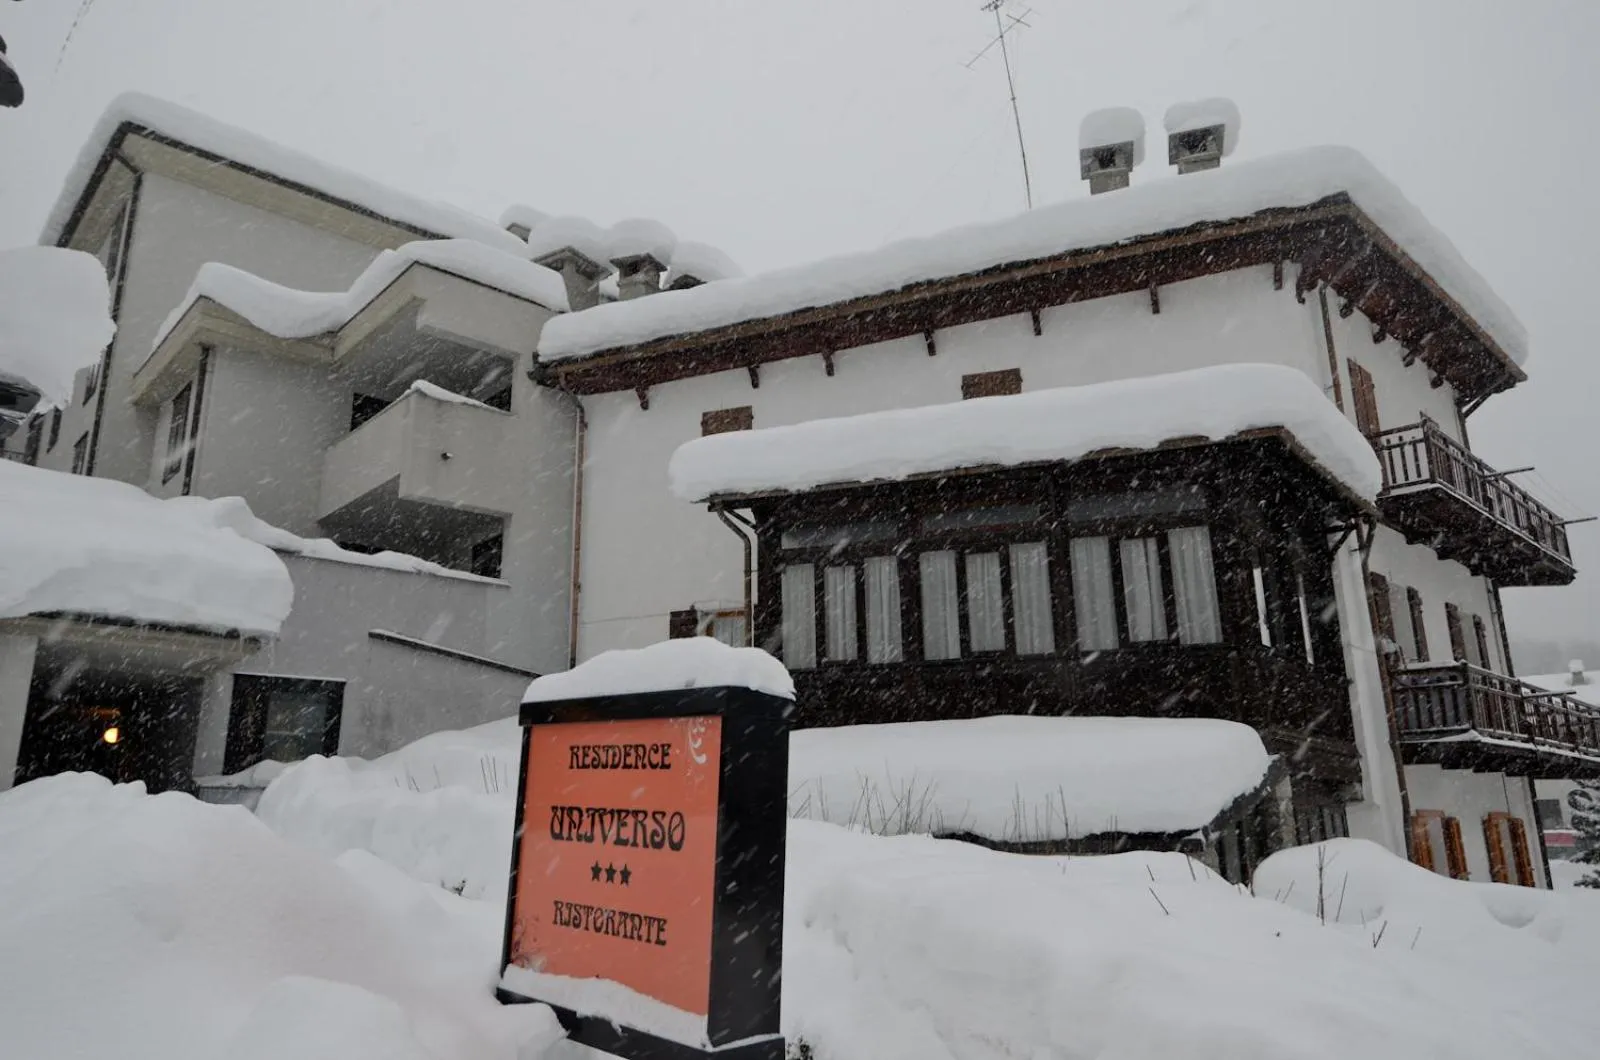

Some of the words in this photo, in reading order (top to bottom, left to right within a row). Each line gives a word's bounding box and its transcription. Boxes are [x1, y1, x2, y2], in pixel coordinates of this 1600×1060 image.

[569, 743, 671, 770] RESIDENCE
[550, 805, 685, 851] UNIVERSO
[552, 900, 667, 946] RISTORANTE
